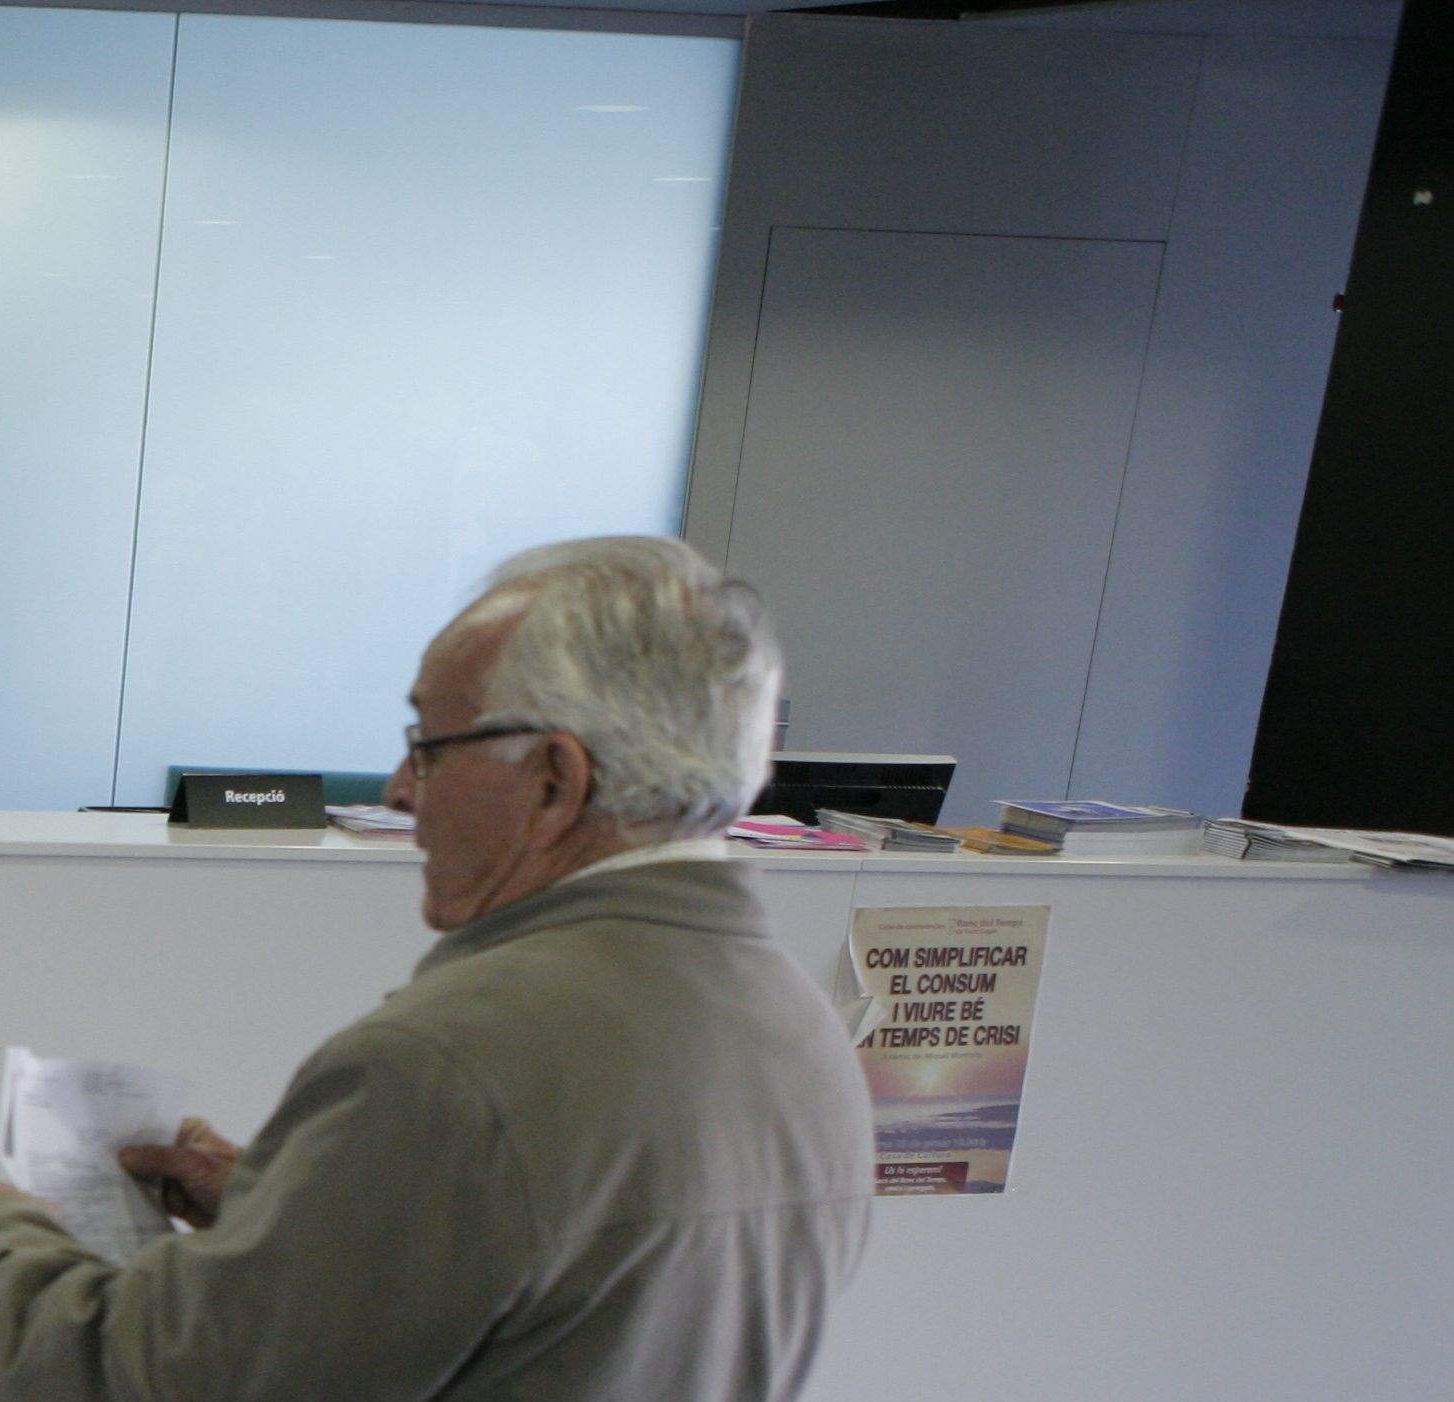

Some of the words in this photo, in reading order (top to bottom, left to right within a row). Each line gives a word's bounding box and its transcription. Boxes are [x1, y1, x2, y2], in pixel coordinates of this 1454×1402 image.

[224, 789, 286, 805] Recepció
[866, 947, 910, 968] COM
[914, 946, 1028, 968] SIMPLIFICAR
[889, 975, 912, 995] EL
[917, 973, 997, 994] CONSUM
[892, 1002, 899, 1022] I
[904, 1001, 956, 1022] VIURE
[960, 997, 985, 1021] BÉ
[880, 1027, 940, 1048] TEMPS
[945, 1025, 969, 1046] DE
[973, 1025, 1021, 1046] CRISI
